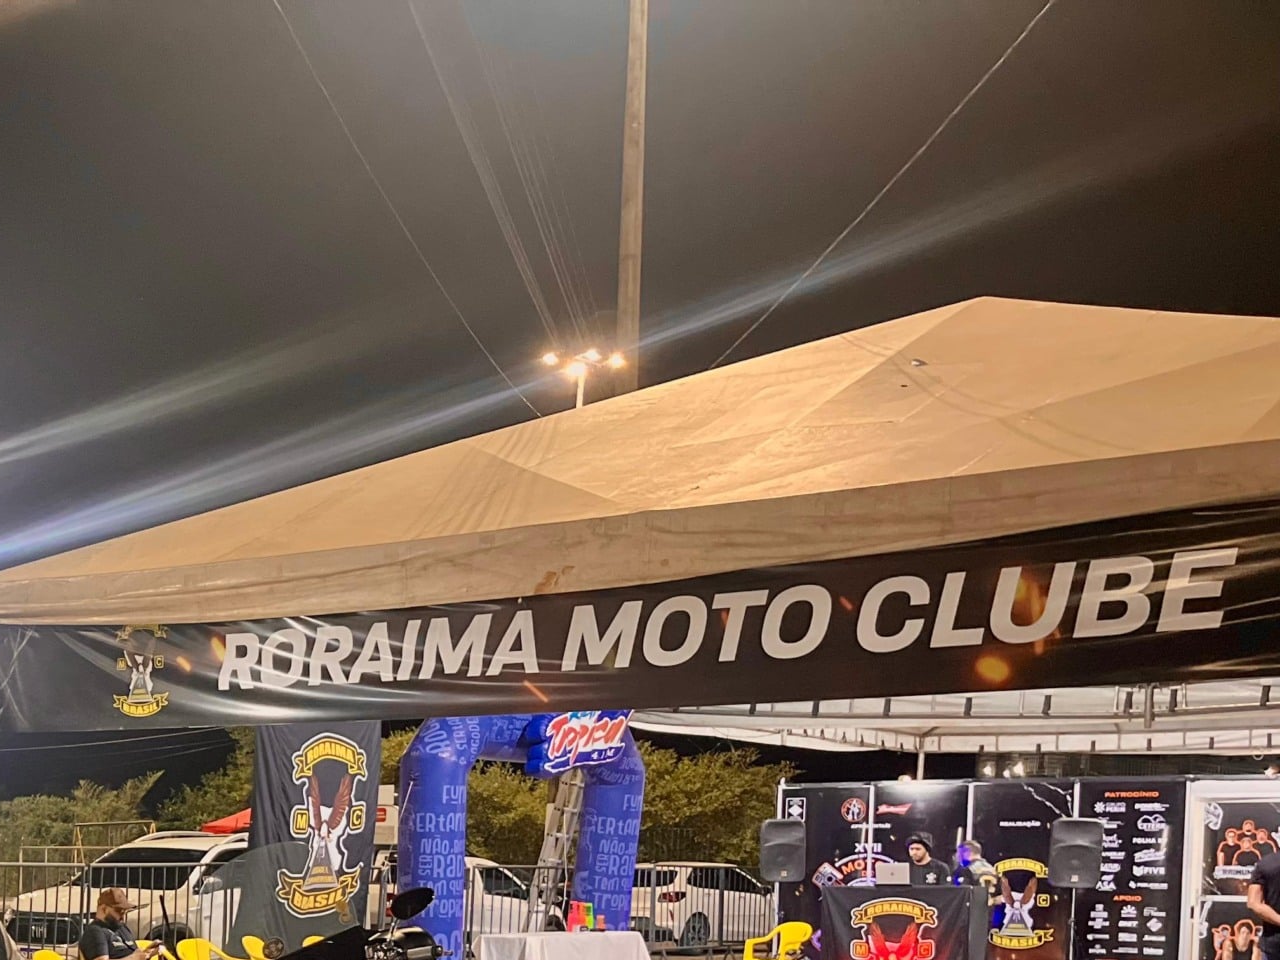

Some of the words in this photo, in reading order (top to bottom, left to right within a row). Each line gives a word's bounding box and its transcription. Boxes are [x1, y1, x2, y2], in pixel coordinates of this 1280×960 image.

[218, 610, 538, 690] RORAIMA
[560, 584, 832, 672] MOTO
[856, 547, 1238, 653] CLUBE
[122, 702, 158, 714] BRASIL
[306, 742, 355, 763] RORAIMA
[866, 903, 920, 917] RORAIMA
